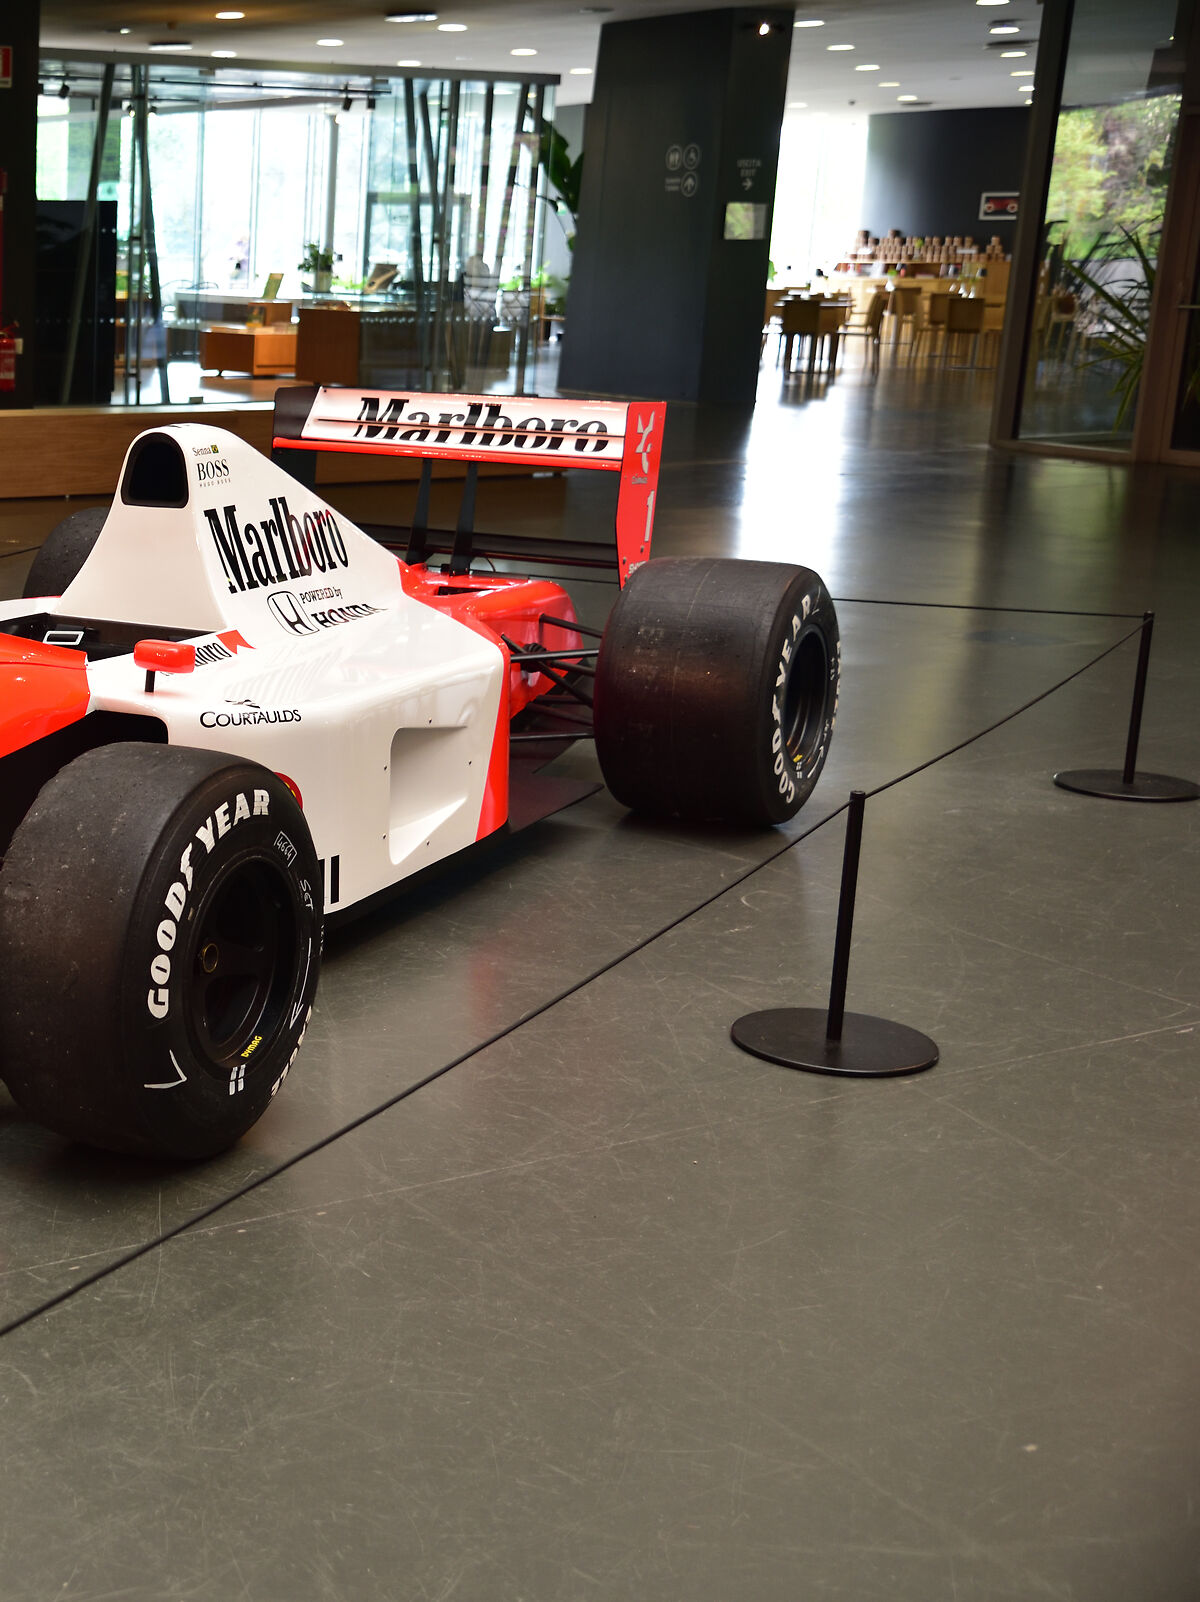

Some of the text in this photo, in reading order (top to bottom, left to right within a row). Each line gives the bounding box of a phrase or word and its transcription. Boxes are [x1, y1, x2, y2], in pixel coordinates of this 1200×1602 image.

[352, 397, 610, 453] Marlboro
[197, 459, 230, 480] BOSS
[204, 496, 349, 594] Marlboro
[300, 586, 343, 604] POWERED by
[311, 604, 388, 628] HONDA
[771, 593, 811, 804] GOODYEAR
[200, 710, 302, 728] COURTAULDS
[148, 789, 271, 1019] GOODYEAR
[241, 1035, 263, 1058] DYMAG
